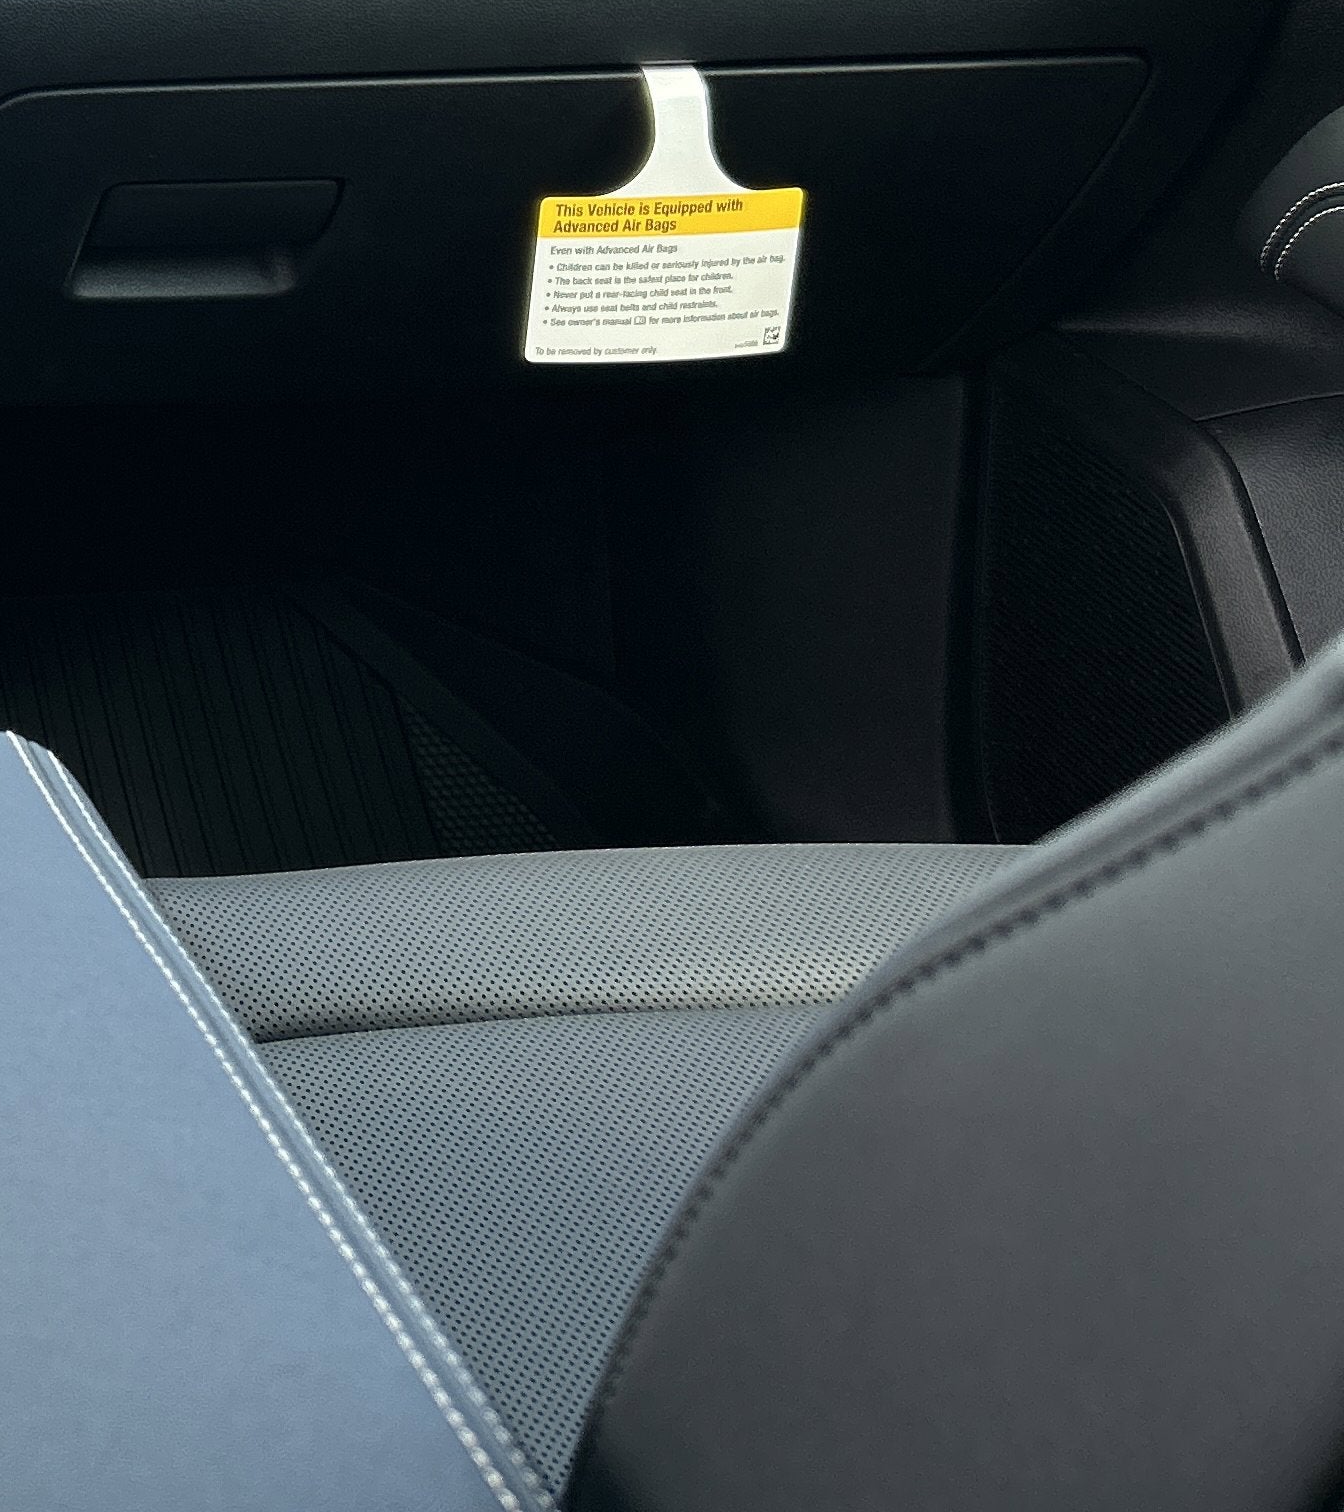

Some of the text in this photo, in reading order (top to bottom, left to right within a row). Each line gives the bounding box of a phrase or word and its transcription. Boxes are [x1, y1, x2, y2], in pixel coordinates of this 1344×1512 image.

[556, 198, 743, 217] This Vehicle is Equipped with
[554, 219, 677, 233] Advanced Air Bags
[551, 244, 678, 255] Even with Advanced Air Bags
[557, 263, 592, 271] Children
[556, 277, 570, 285] The
[573, 276, 592, 284] back
[624, 275, 636, 283] the
[536, 347, 544, 355] To
[547, 347, 556, 355] be
[558, 347, 591, 355] removed
[594, 348, 602, 356] by
[605, 347, 639, 355] customer
